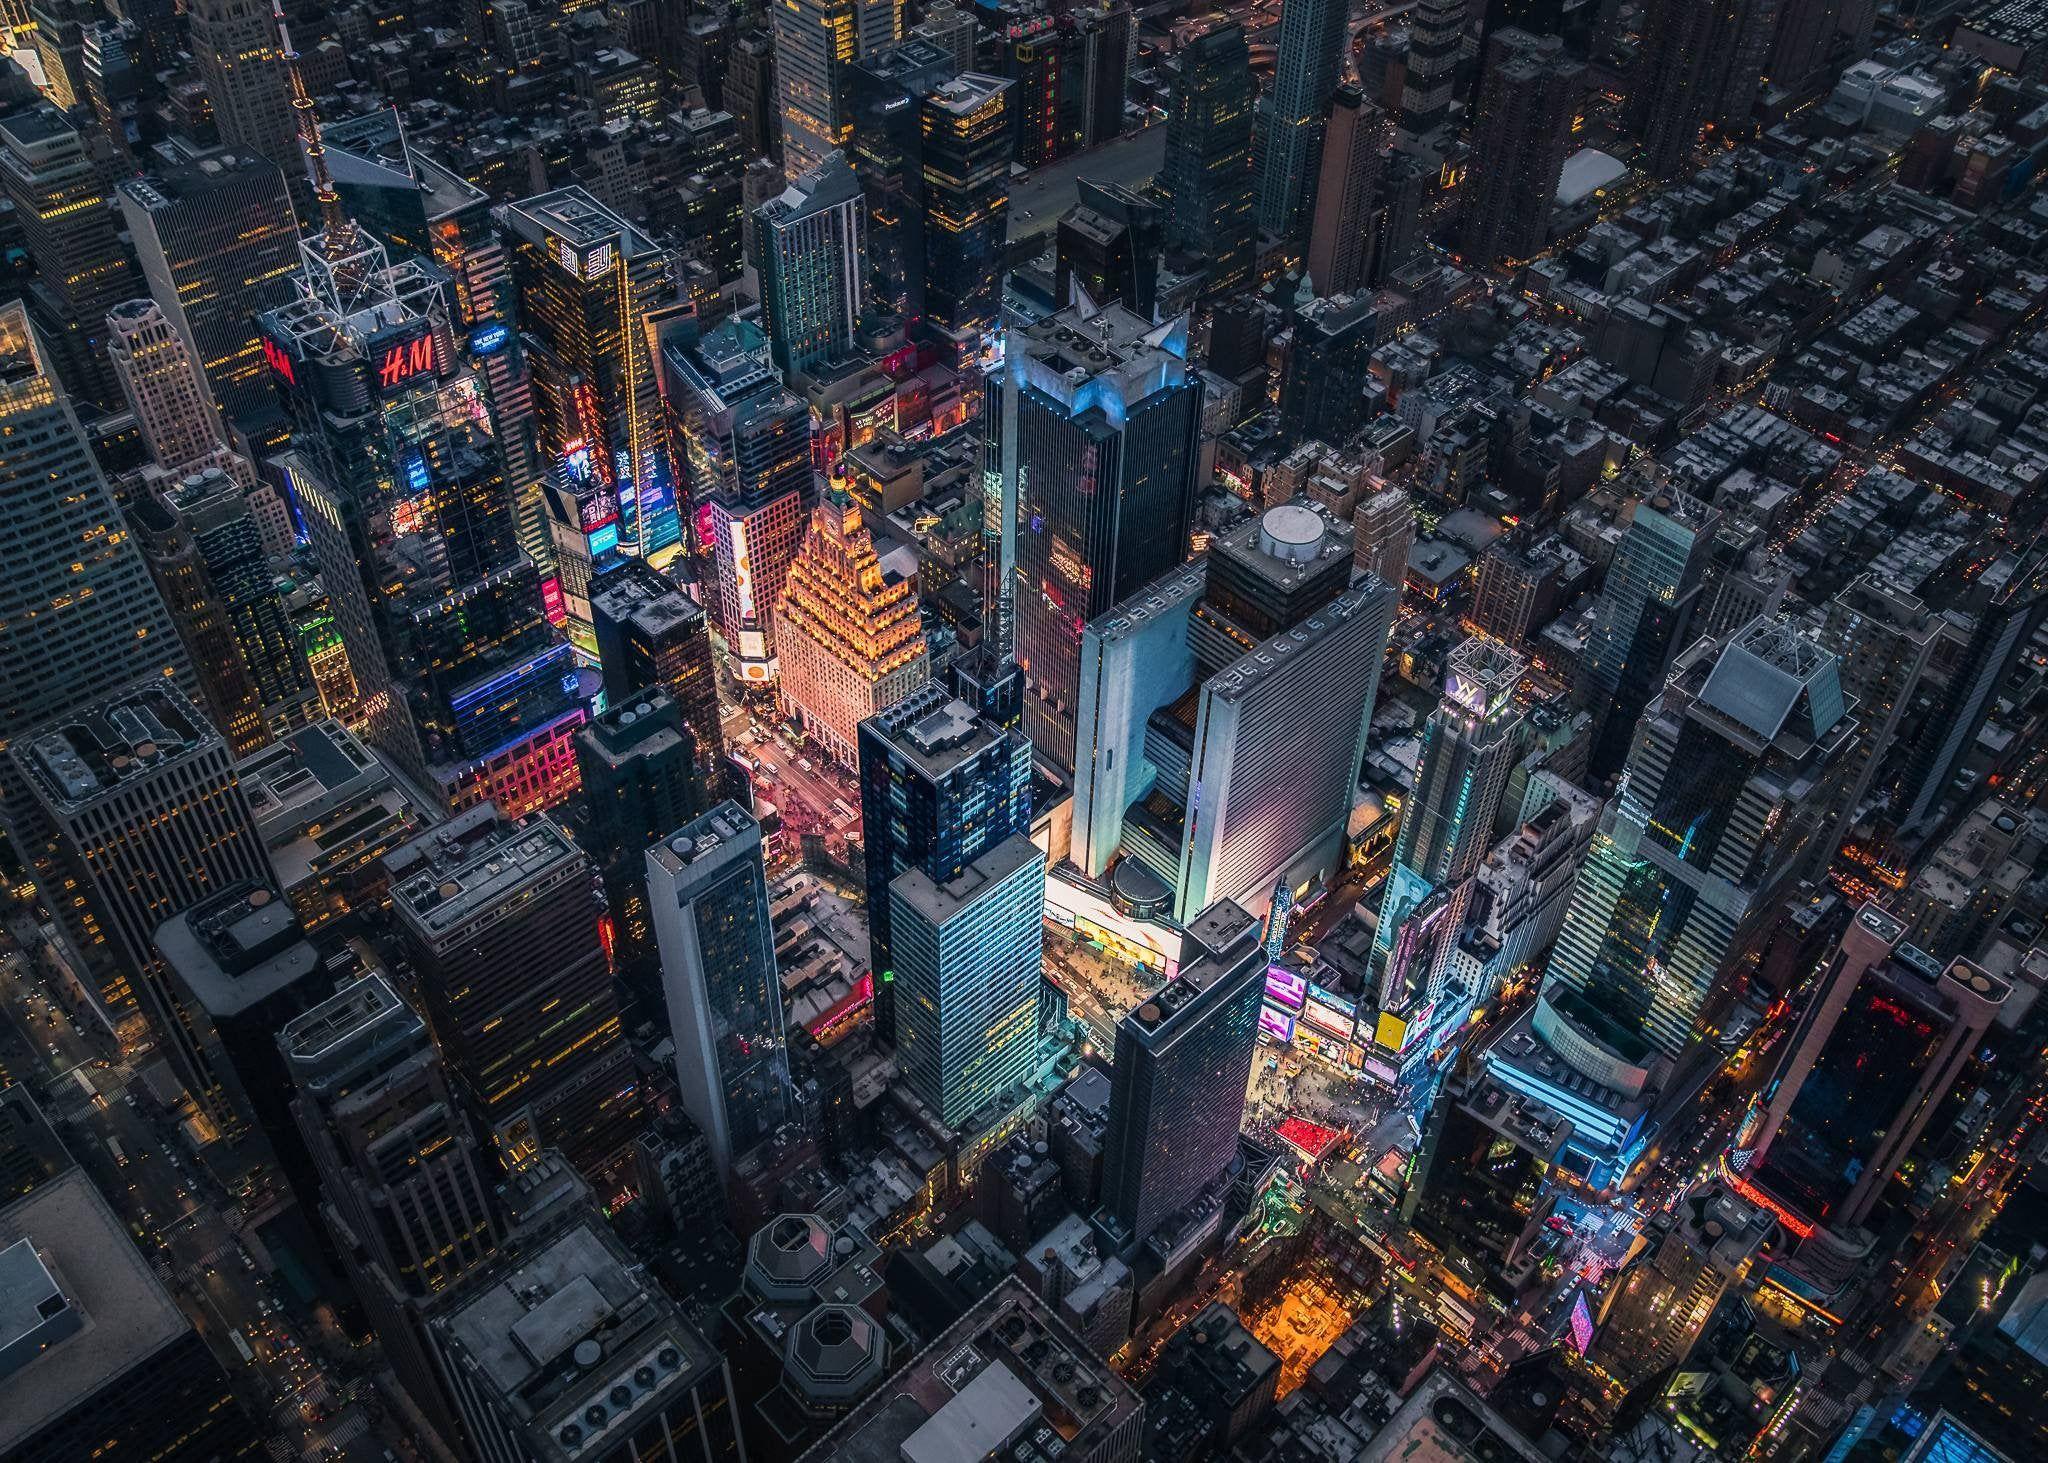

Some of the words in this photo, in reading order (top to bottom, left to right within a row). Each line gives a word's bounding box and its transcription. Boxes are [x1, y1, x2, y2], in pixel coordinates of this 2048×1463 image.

[379, 334, 432, 387] H&M
[574, 388, 591, 442] ERNST
[1455, 674, 1478, 705] W
